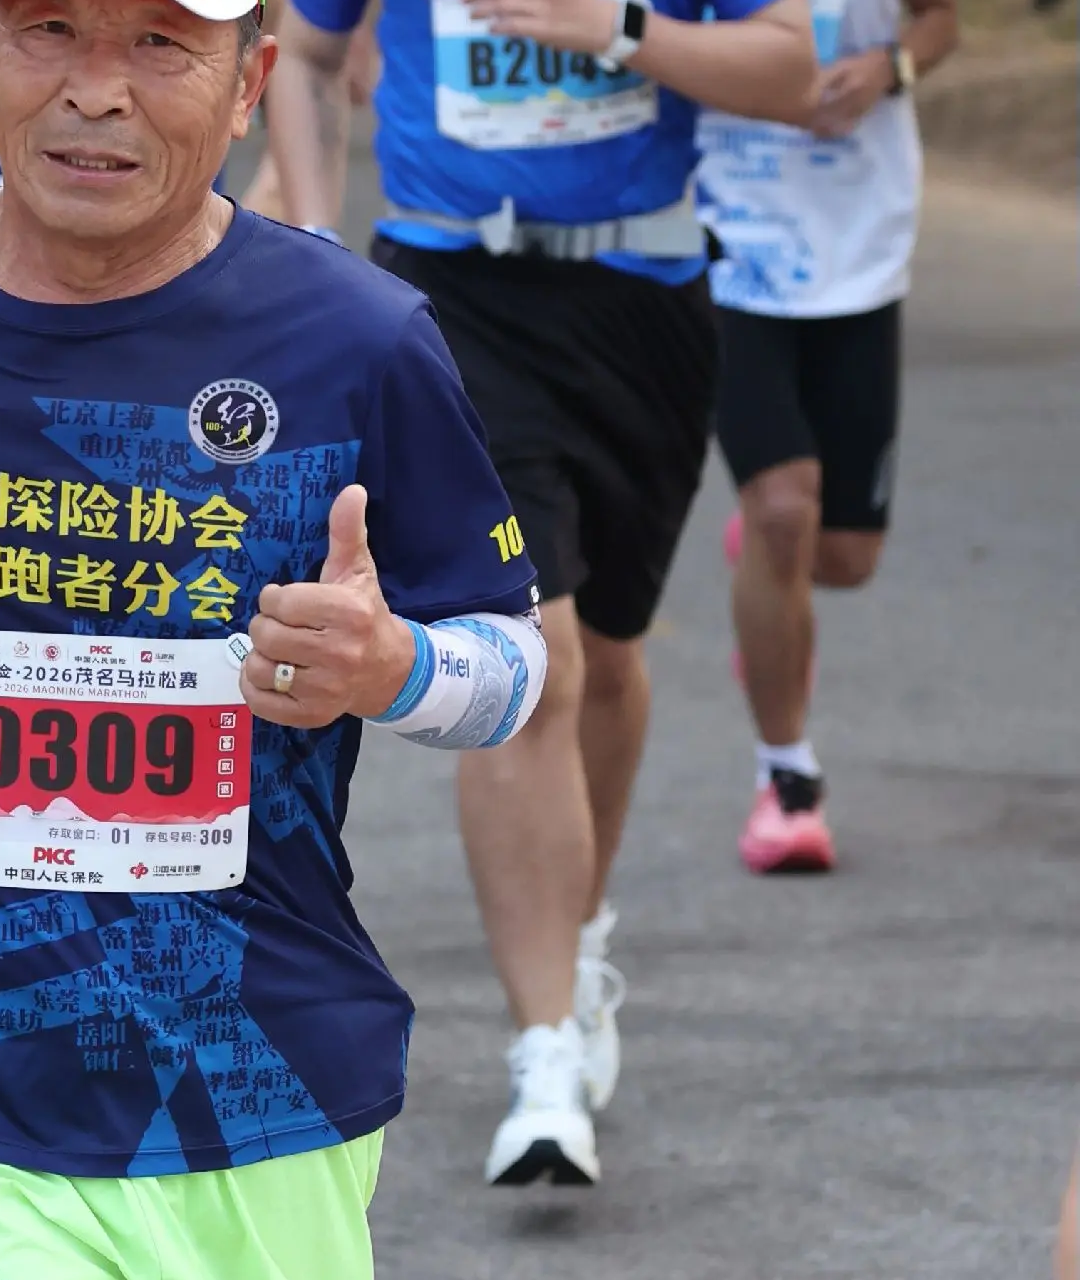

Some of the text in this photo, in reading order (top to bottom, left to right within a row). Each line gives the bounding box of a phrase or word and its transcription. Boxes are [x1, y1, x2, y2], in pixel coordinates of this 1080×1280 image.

[470, 39, 628, 88] B204
[205, 422, 224, 431] 100+
[90, 646, 112, 655] PICC
[32, 685, 84, 696] MAOMING
[88, 688, 148, 699] MARATHON
[111, 828, 130, 844] 01
[200, 829, 232, 845] 309
[33, 847, 76, 865] PICC
[4, 867, 104, 884] 中国人民保险
